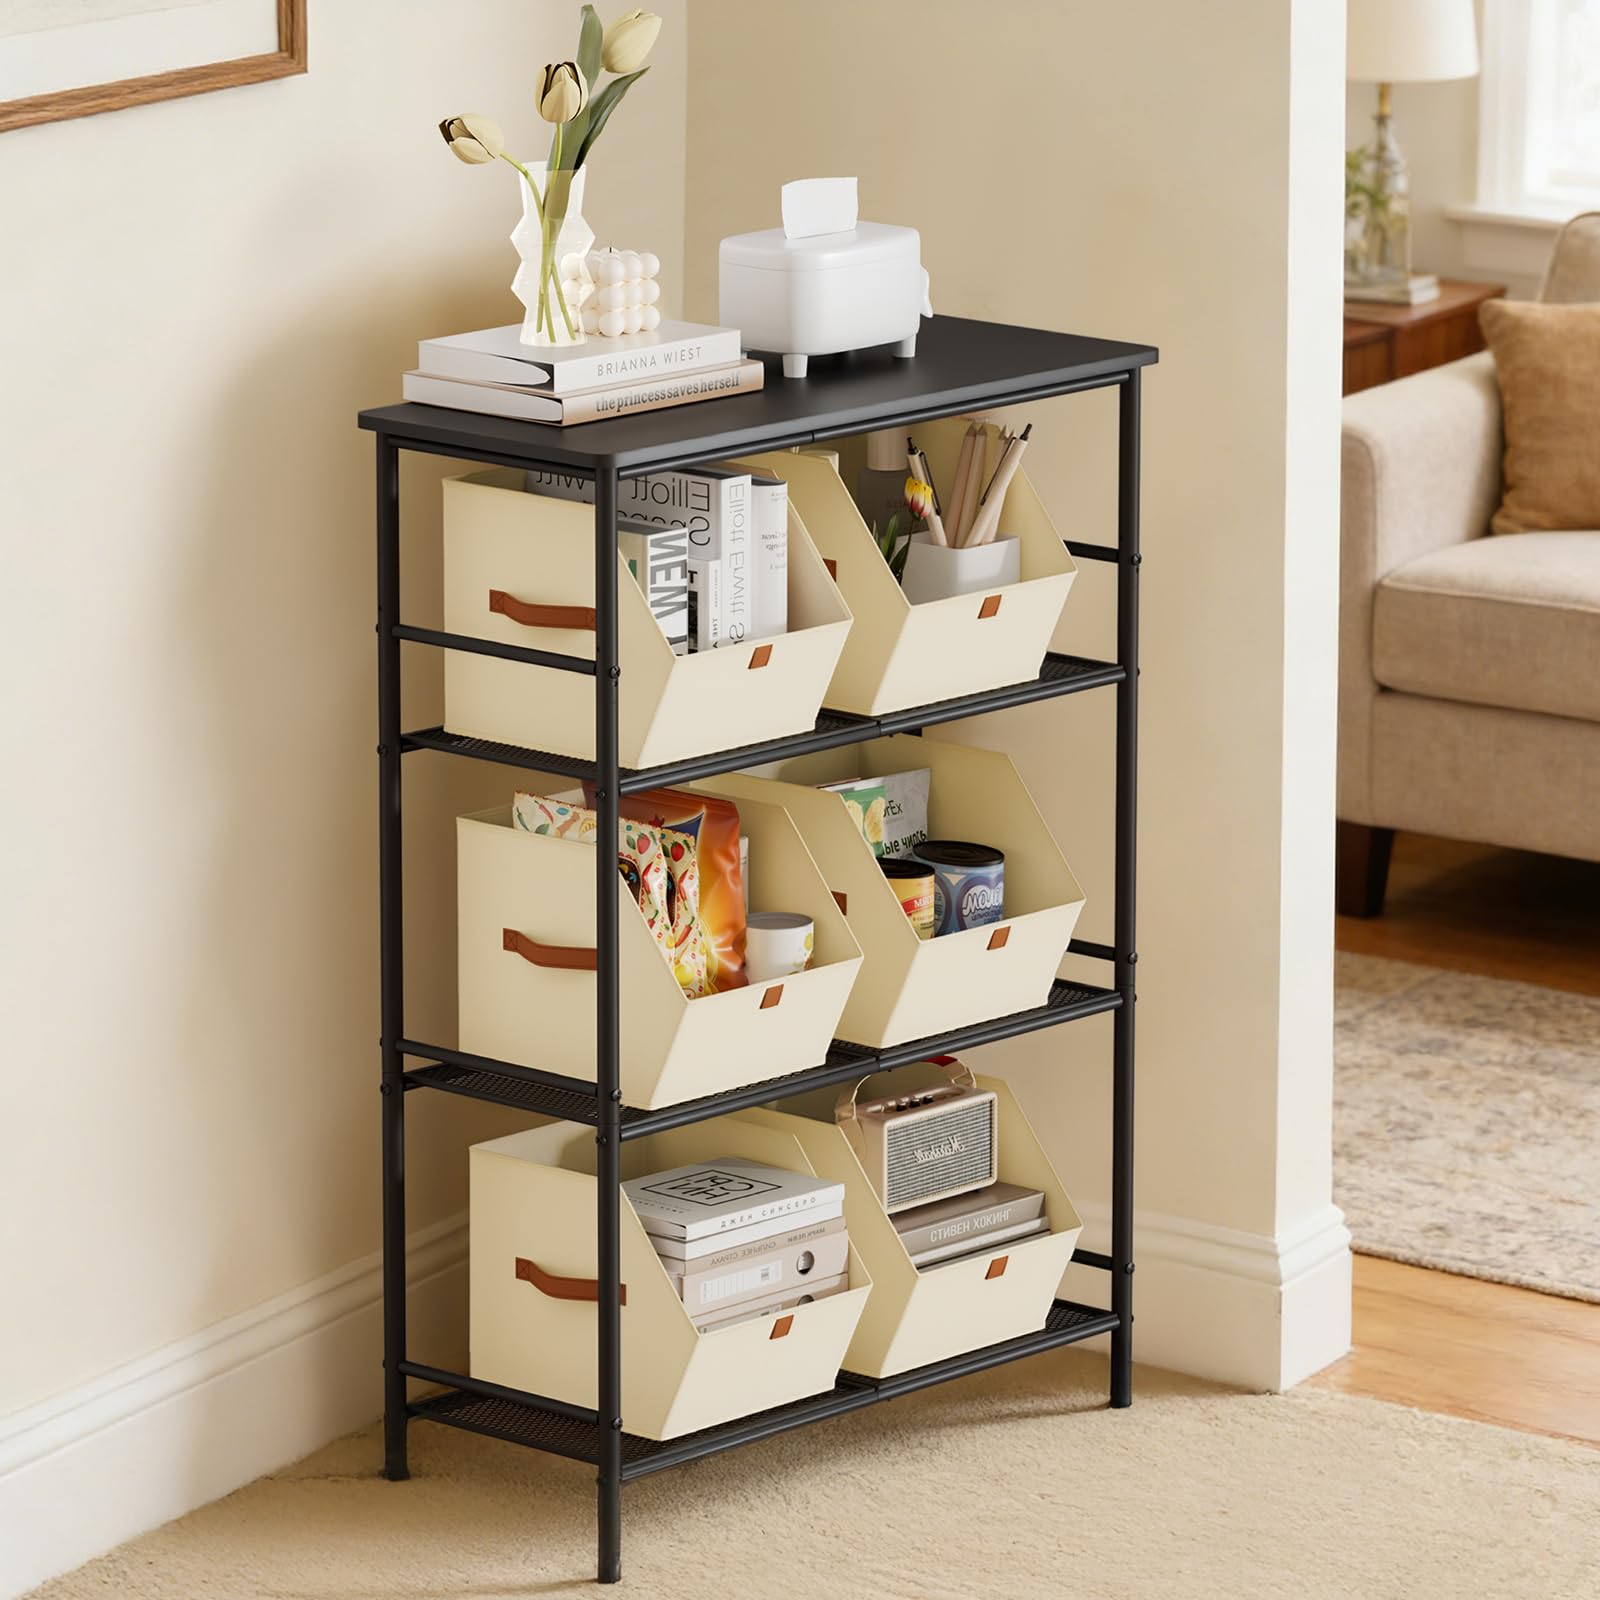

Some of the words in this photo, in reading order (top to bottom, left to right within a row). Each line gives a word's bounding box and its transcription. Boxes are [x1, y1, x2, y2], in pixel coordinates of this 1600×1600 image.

[597, 354, 657, 377] BRIANNA
[663, 346, 703, 365] WIEST
[721, 1213, 752, 1229] ДЖЕН
[762, 1197, 816, 1217] СИНСЕРО
[930, 1220, 970, 1243] СТИВЕН
[973, 1208, 1013, 1230] ХОКИНГ
